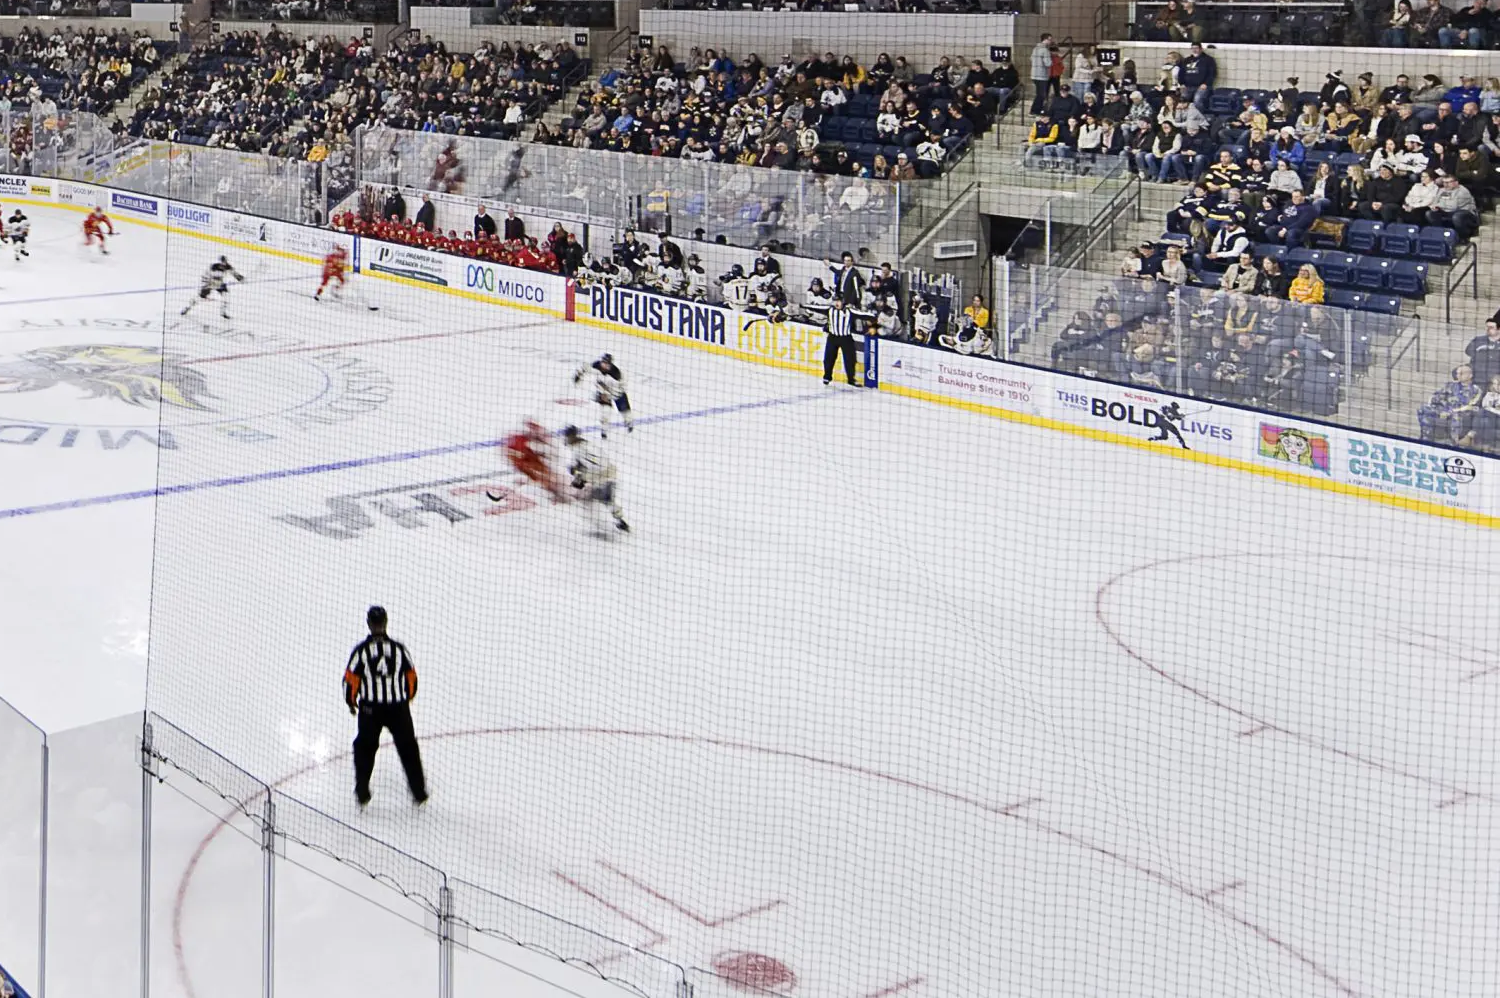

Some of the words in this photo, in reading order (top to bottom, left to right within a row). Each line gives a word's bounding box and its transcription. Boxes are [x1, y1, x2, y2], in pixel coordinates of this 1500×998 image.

[1100, 52, 1117, 60] 115
[139, 200, 154, 210] BANK
[167, 205, 184, 219] BUD
[185, 208, 210, 223] LIGHT
[395, 258, 419, 269] PREMIER
[405, 252, 431, 263] PREMIER
[498, 279, 544, 303] MIDCO
[735, 285, 749, 300] 17
[591, 285, 726, 346] AUGUSTANA
[938, 363, 973, 379] Trusted
[975, 372, 1033, 392] Community
[938, 375, 977, 392] Banking
[978, 384, 1005, 397] Since
[1007, 390, 1030, 402] 1910
[1056, 390, 1089, 406] THIS
[1091, 398, 1161, 428] BOLD
[1181, 418, 1233, 441] LIVES
[1348, 457, 1459, 497] GAZER
